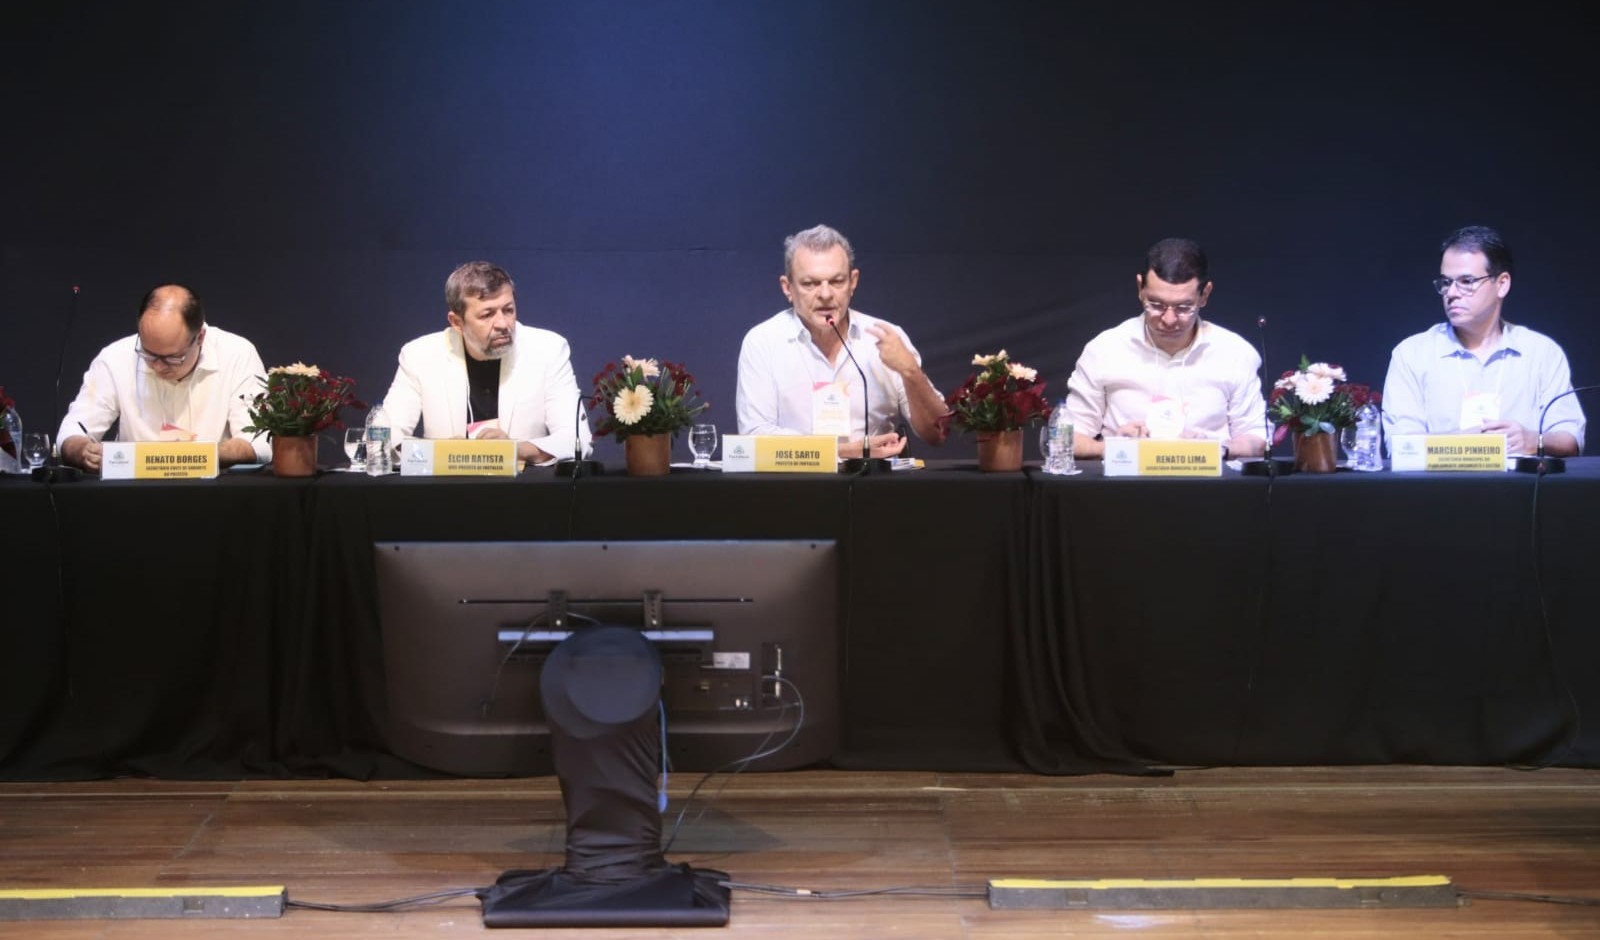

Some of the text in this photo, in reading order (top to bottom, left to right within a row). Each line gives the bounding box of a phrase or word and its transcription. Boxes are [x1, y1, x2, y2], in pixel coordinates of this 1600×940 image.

[795, 450, 820, 459] SARTO
[1427, 446, 1463, 454] MARCELO
[1464, 446, 1500, 454] PINHEIRO
[145, 455, 208, 464] RENATO BORGES
[448, 453, 504, 463] ÉLCIO BATISTA
[1156, 455, 1207, 464] RENATO LIMA
